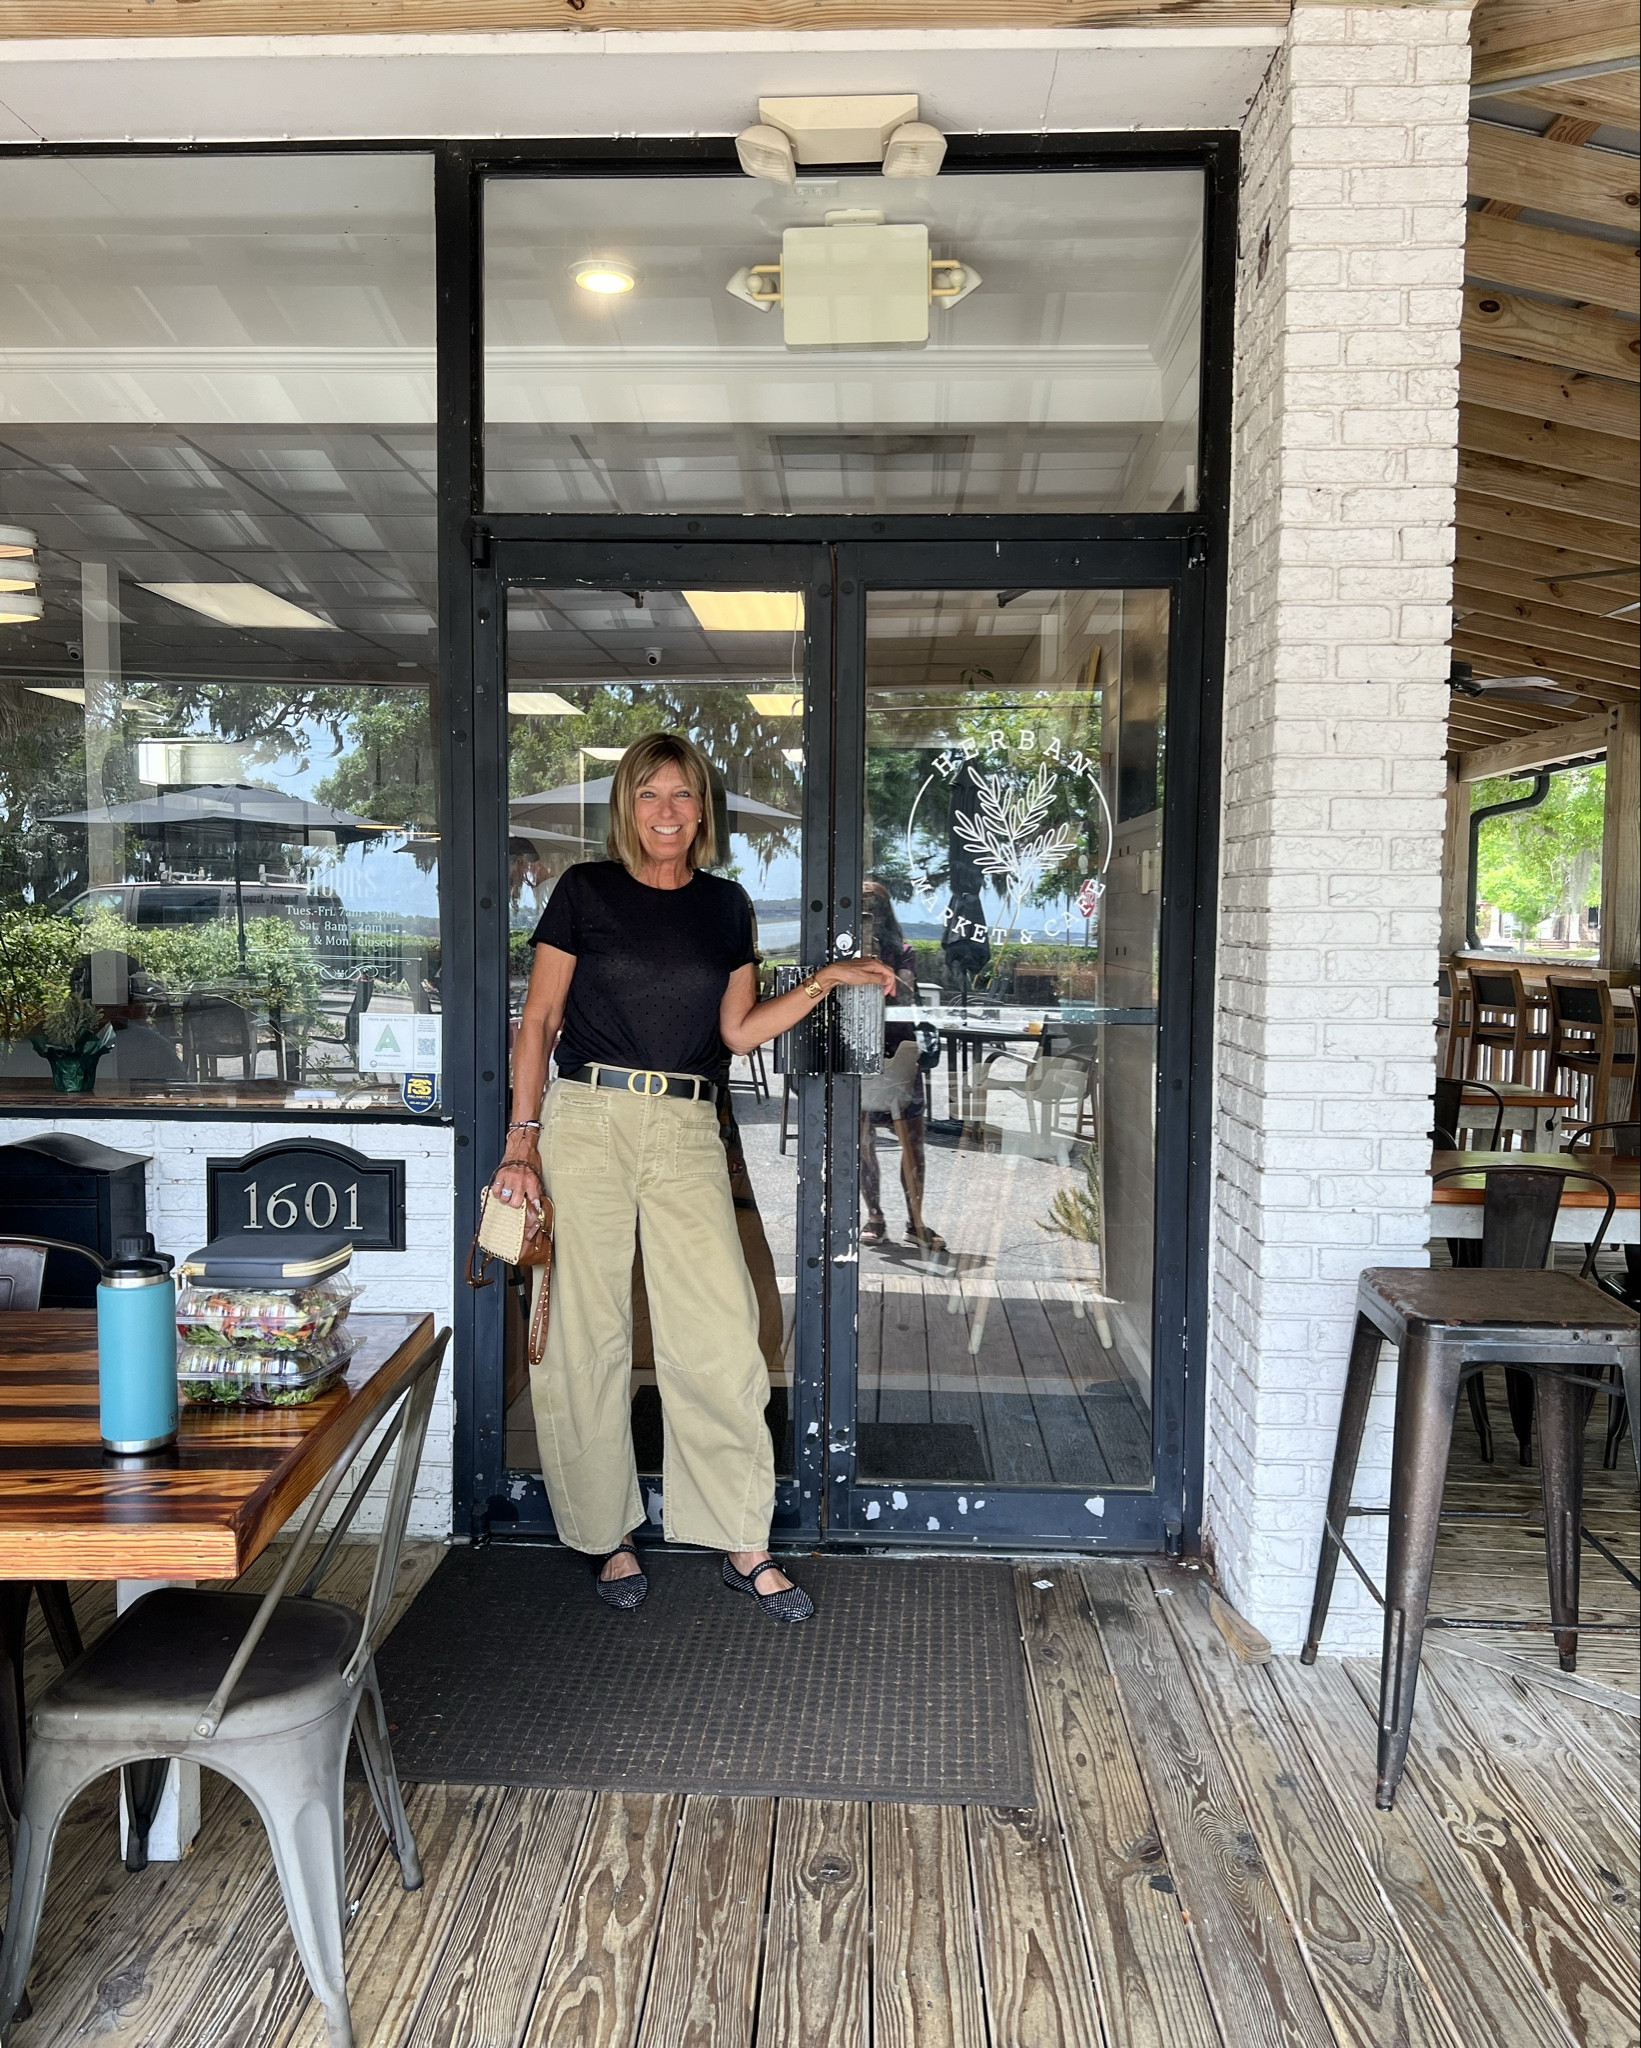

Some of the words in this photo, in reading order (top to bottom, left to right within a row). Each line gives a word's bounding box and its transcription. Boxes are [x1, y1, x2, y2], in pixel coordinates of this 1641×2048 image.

[931, 730, 1092, 777] HERBAN
[306, 866, 377, 898] HOURS
[285, 905, 336, 916] Tues.-Fri.
[339, 907, 362, 917] 7am
[911, 876, 1007, 946] MARKET
[1020, 929, 1033, 945] &
[1044, 879, 1106, 937] CAFE
[299, 920, 319, 931] Sat.
[324, 921, 347, 931] 8am
[358, 922, 382, 933] 2pm
[314, 935, 323, 945] &
[325, 936, 352, 946] Mon.
[357, 937, 393, 947] Closed
[375, 1024, 401, 1052] A
[243, 1181, 363, 1230] 1601
